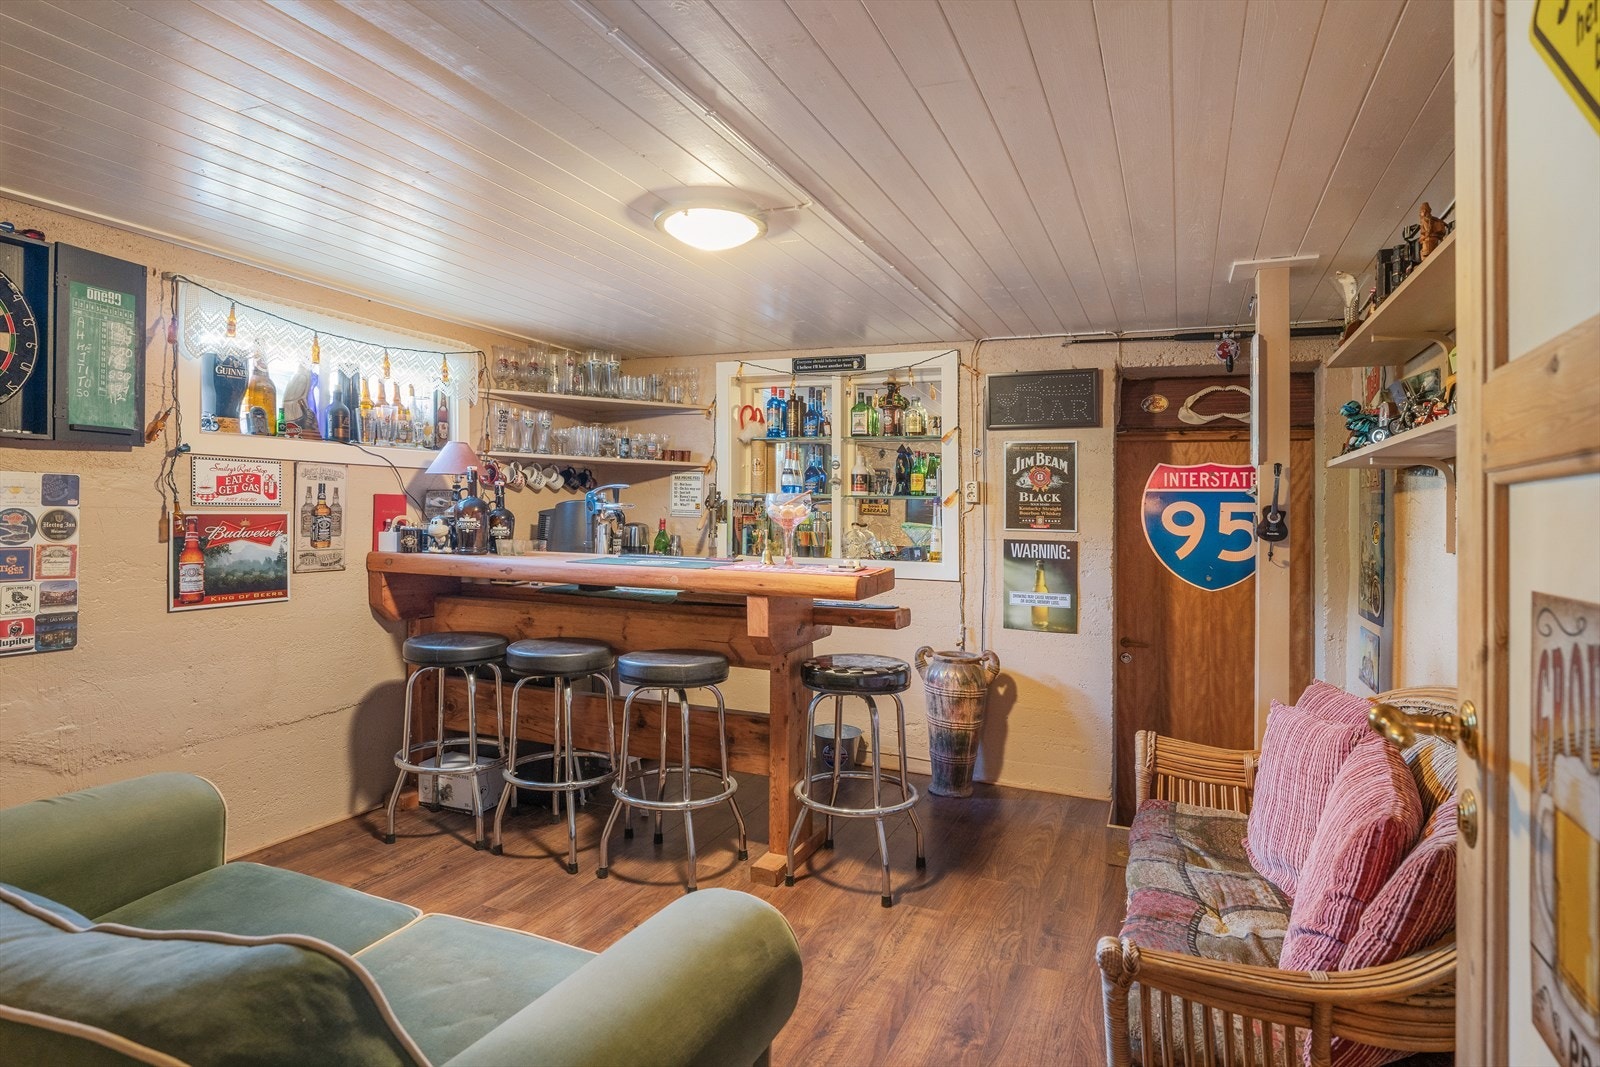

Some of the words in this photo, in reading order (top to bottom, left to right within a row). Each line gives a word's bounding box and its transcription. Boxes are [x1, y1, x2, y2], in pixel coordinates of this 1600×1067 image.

[215, 365, 248, 376] GUINNE
[1024, 396, 1092, 421] BAR
[1012, 455, 1035, 475] JIM
[1035, 452, 1069, 475] BEAM
[251, 465, 268, 476] Stop
[225, 475, 243, 485] EAT
[245, 474, 255, 483] &
[1163, 472, 1257, 487] INTERSTATE
[219, 484, 239, 494] GET
[241, 483, 260, 492] GAS
[1019, 491, 1061, 503] BLACK
[204, 525, 285, 541] Budweiser
[1161, 501, 1257, 562] 95
[1010, 542, 1071, 560] WARNING:
[0, 564, 25, 574] Tiger
